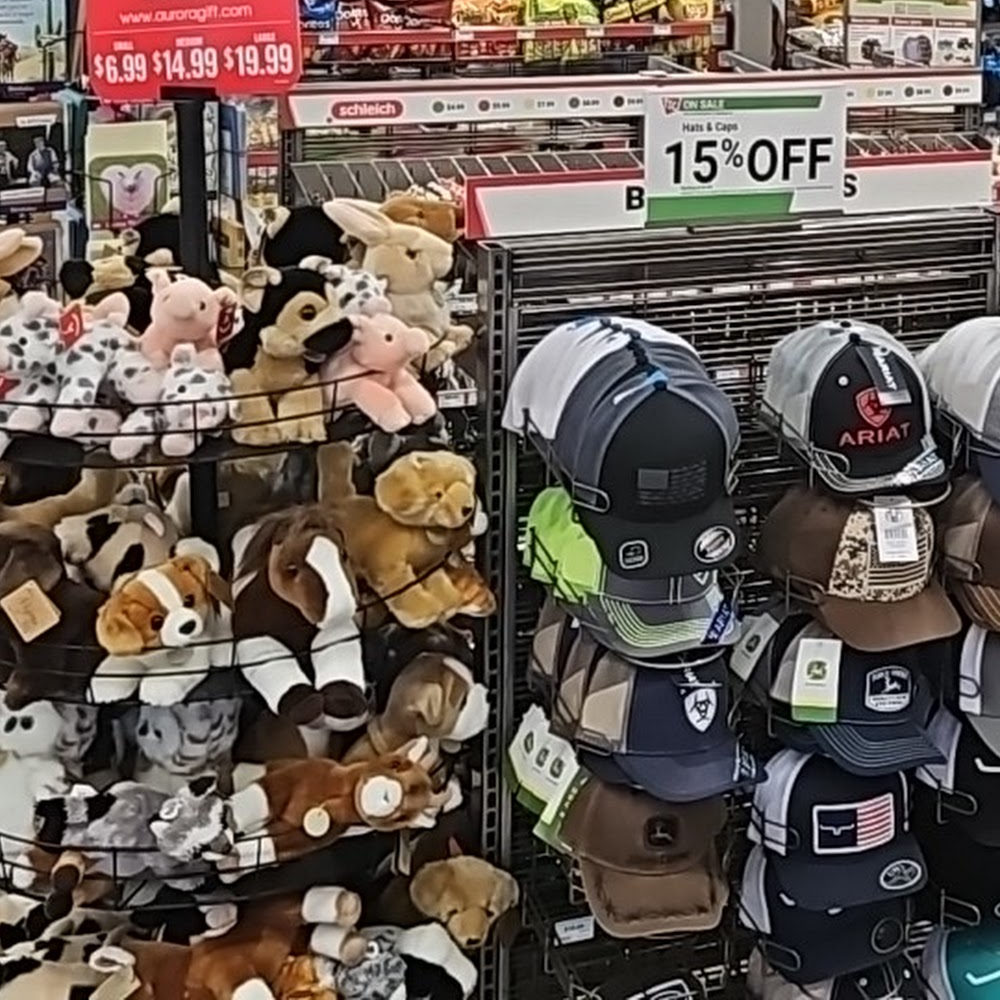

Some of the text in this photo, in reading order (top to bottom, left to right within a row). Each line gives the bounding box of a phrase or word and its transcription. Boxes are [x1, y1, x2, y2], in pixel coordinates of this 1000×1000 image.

[119, 4, 252, 24] www.auroragift.com
[94, 42, 294, 84] $6.99 $14.99 $19.99
[339, 103, 396, 116] schleich
[683, 99, 699, 110] ON
[700, 99, 725, 110] SALE
[682, 121, 738, 133] Hats & Caps
[839, 422, 911, 448] ARIAT
